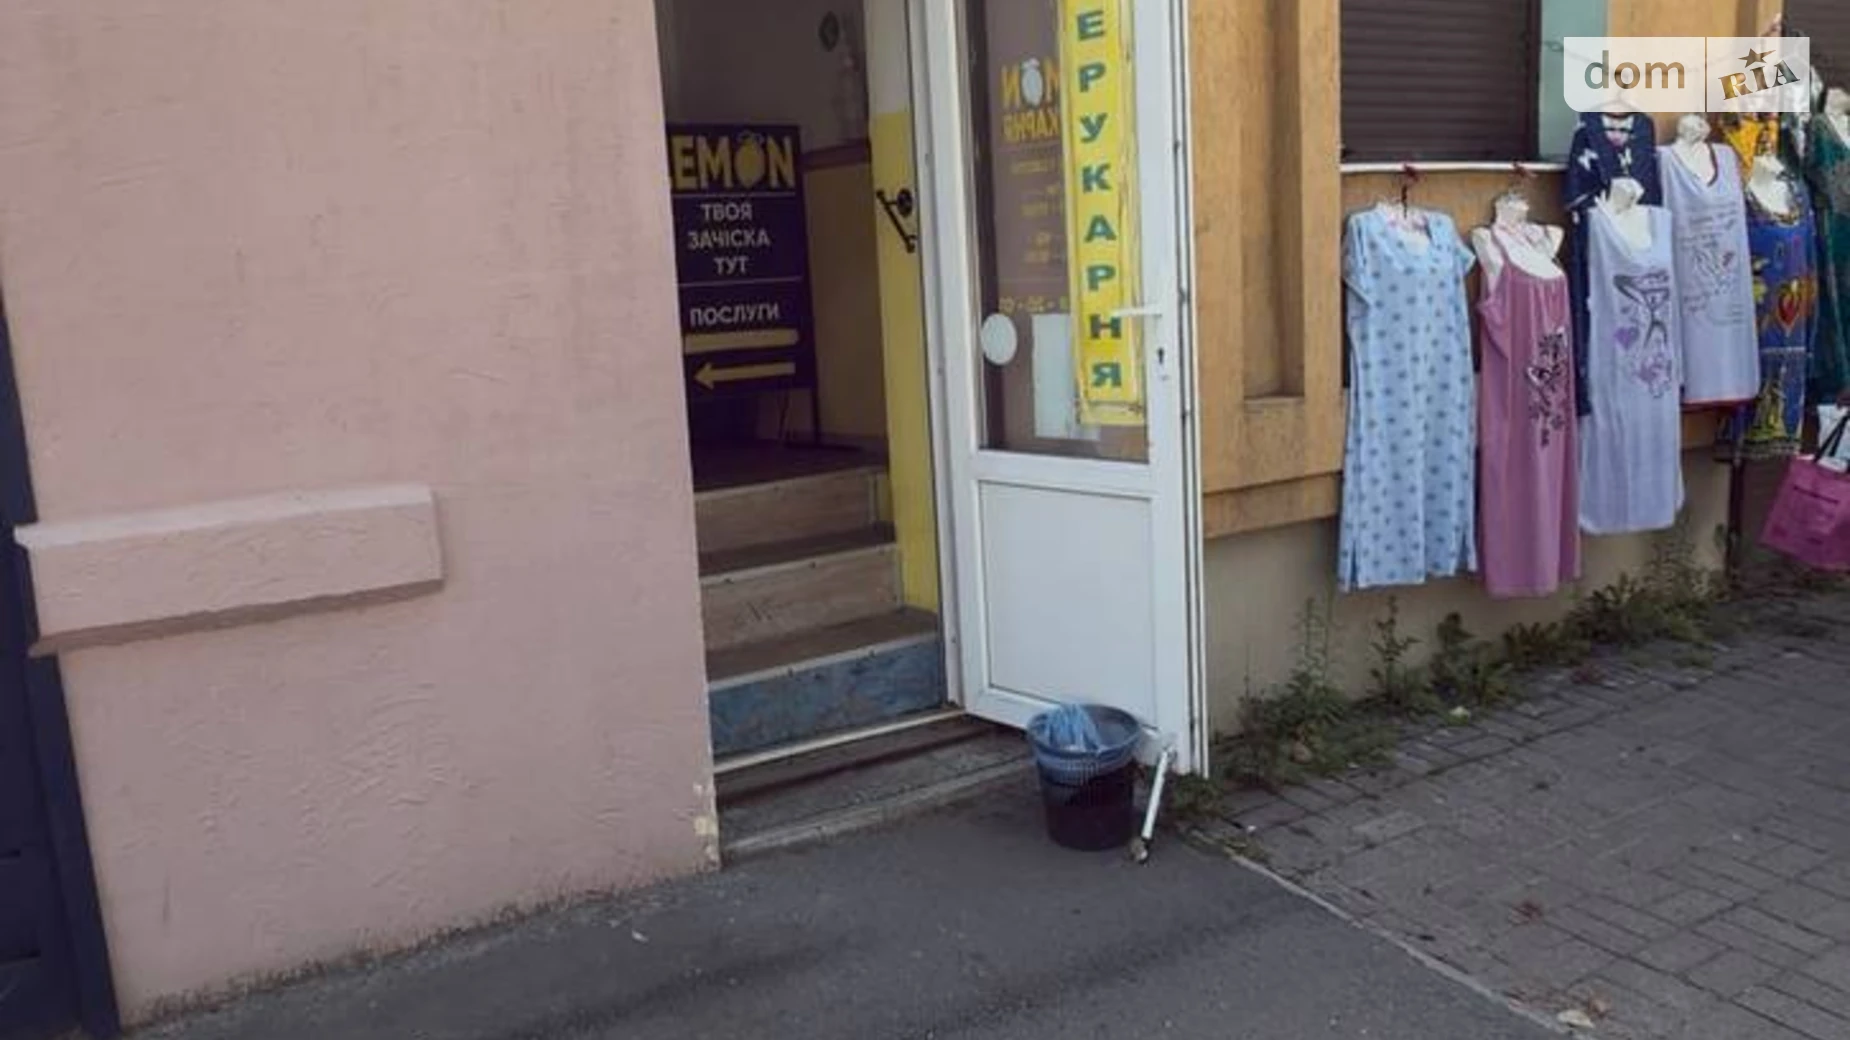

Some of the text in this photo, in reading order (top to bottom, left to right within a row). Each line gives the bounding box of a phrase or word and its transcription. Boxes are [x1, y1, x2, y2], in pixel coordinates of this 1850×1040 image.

[669, 131, 796, 190] EMON
[701, 202, 752, 222] ТВОЯ
[688, 228, 771, 250] ЗАЧІСКА
[713, 255, 750, 275] ТУТ
[690, 303, 780, 327] ПОСЛУГИ
